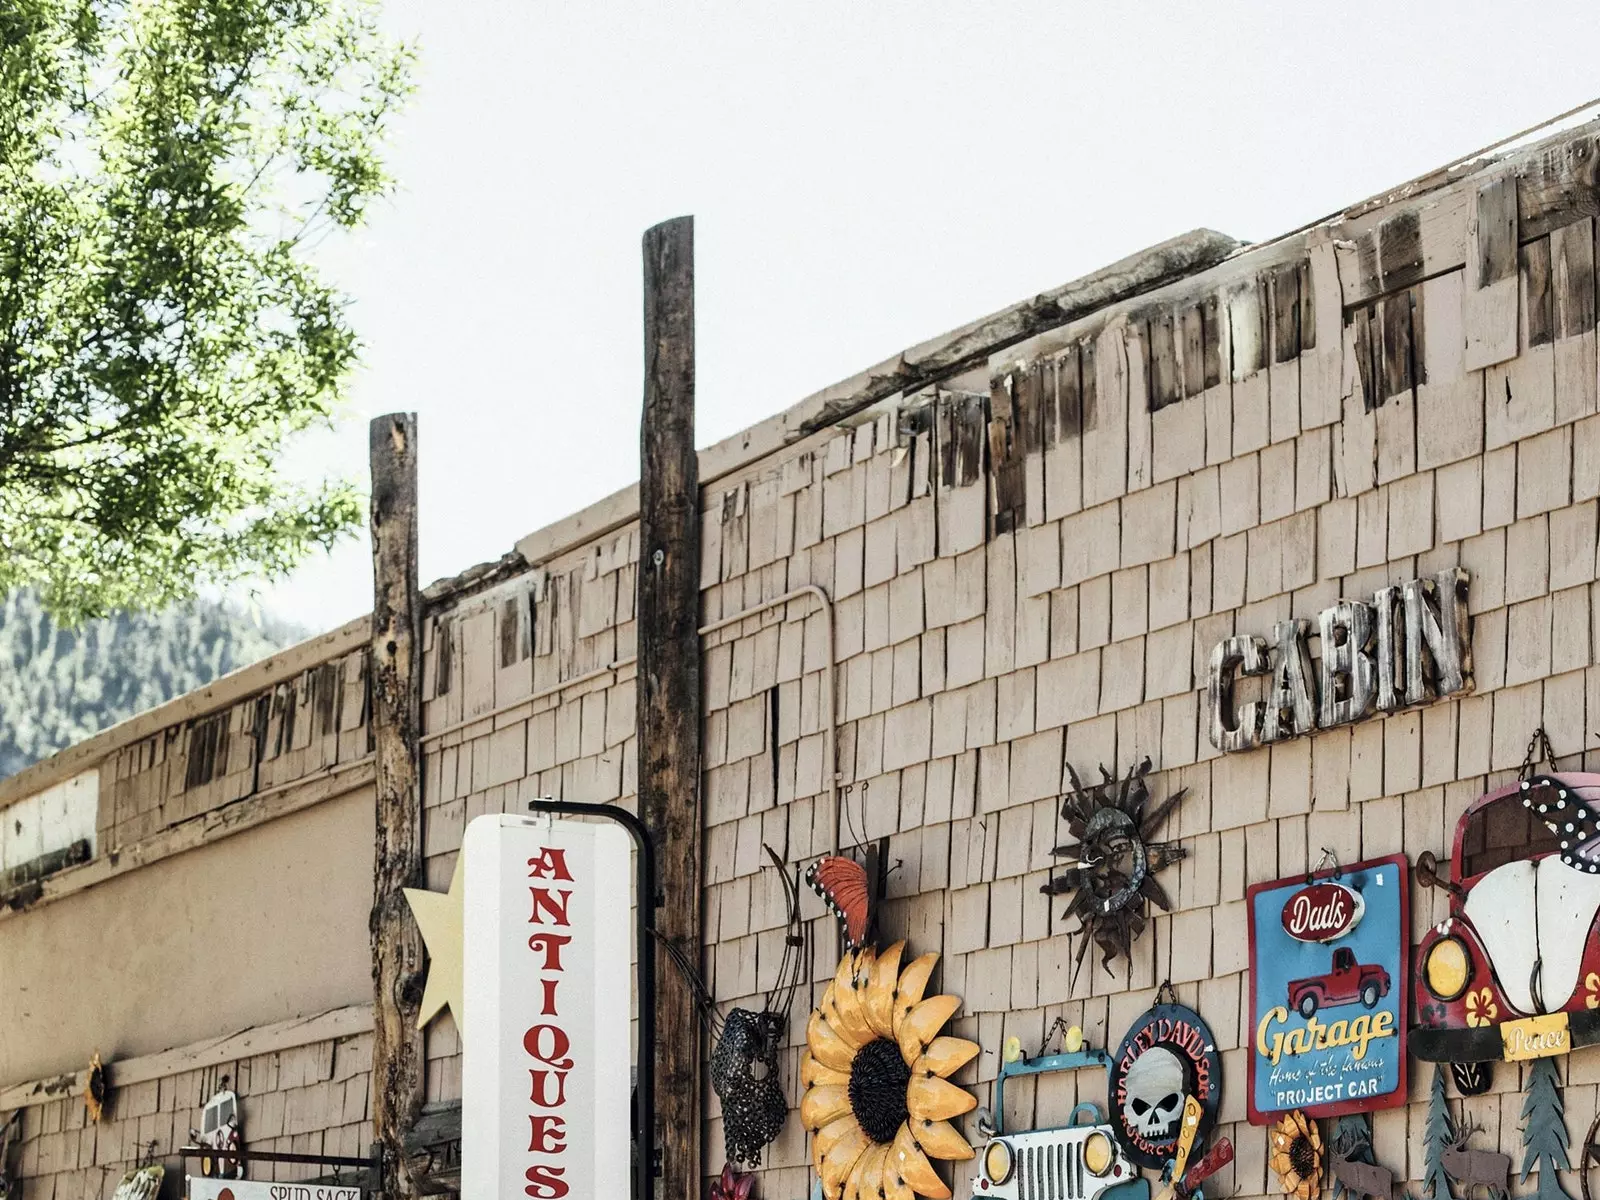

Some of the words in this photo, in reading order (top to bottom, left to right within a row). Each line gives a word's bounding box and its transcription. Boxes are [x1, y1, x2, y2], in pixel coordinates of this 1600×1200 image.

[1207, 567, 1473, 752] CABIN
[1290, 890, 1347, 935] Dad's
[523, 847, 575, 1199] ANTIQUES
[1257, 1006, 1396, 1066] Garage
[1508, 1026, 1567, 1055] Peace
[1269, 1067, 1301, 1086] Home
